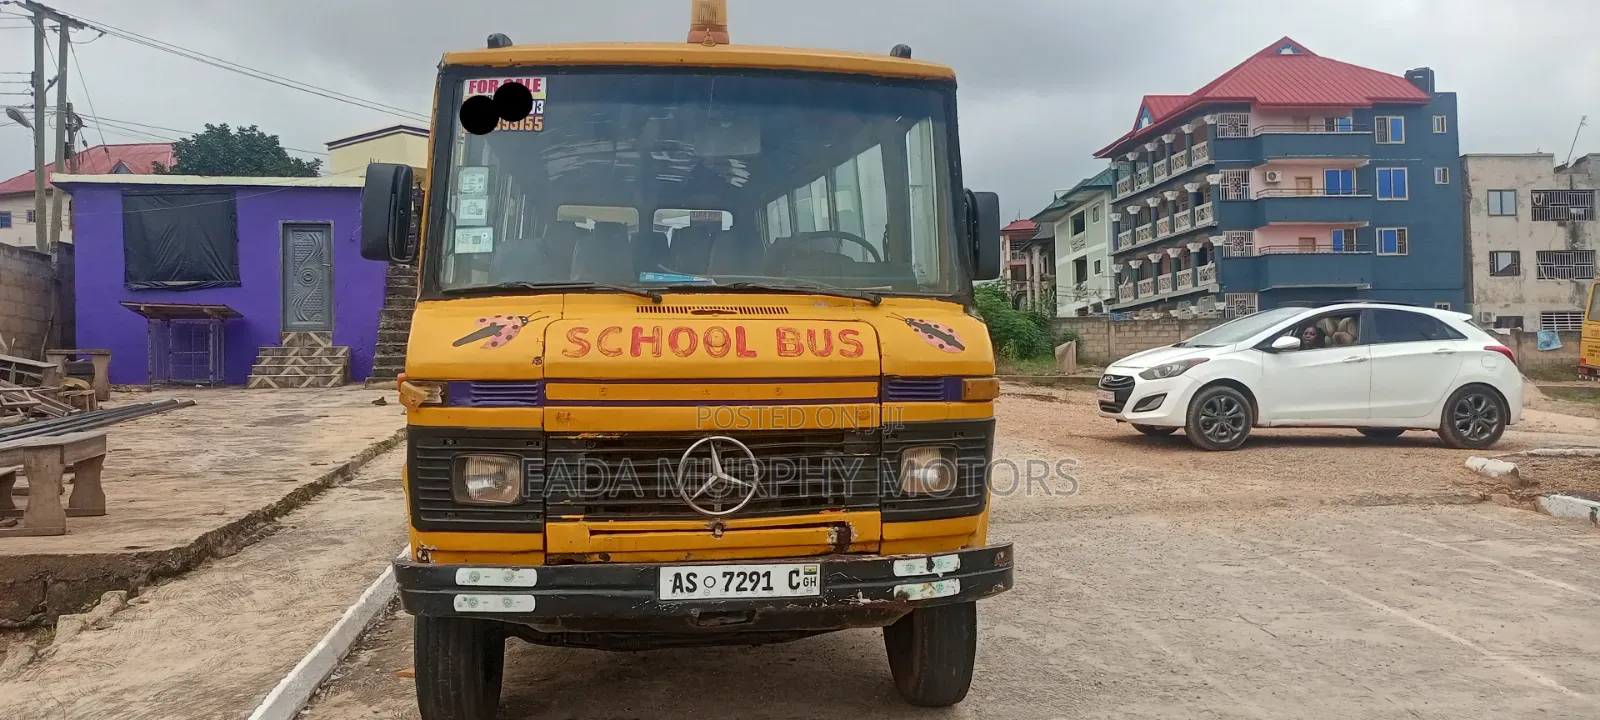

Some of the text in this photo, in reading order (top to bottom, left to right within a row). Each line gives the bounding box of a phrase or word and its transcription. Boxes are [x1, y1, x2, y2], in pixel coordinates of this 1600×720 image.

[468, 77, 542, 94] FOR LE
[562, 325, 865, 358] SCHOOL BUS
[671, 570, 801, 594] AS 7291 C
[803, 576, 817, 588] GH
